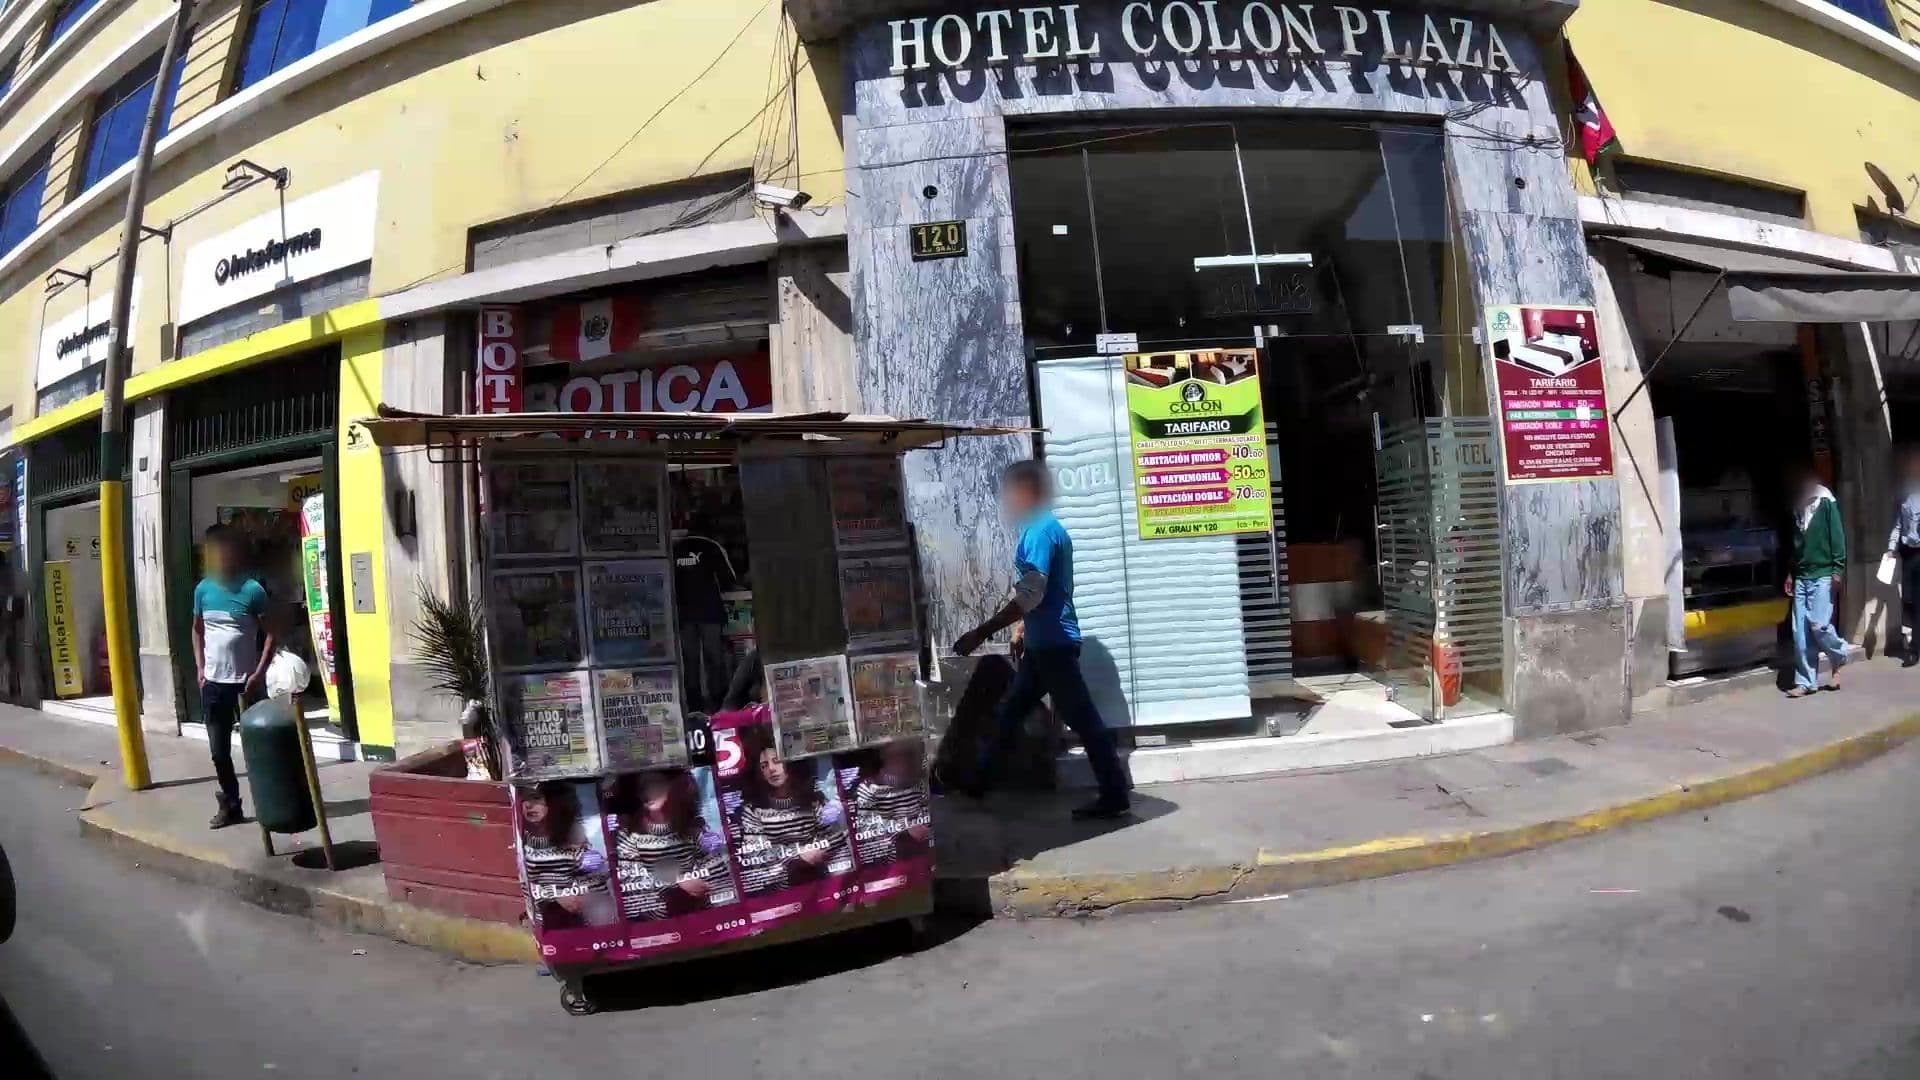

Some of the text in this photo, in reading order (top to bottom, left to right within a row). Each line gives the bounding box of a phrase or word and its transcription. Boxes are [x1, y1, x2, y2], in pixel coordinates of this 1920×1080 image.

[888, 1, 1520, 73] HOTEL COLON PLAZA
[918, 225, 959, 248] 120
[484, 310, 517, 415] BOT
[1529, 378, 1577, 387] TARIFARIO
[1170, 400, 1222, 413] COLON
[1165, 420, 1231, 433] TARIFARIO
[1138, 453, 1222, 466] HABITACIÓN JUNIOR
[1232, 447, 1264, 459] 40.00
[1056, 462, 1115, 491] OTEL
[1140, 472, 1222, 485] HAB. MATRIMONIAL
[1233, 465, 1265, 479] 50.00
[1141, 491, 1224, 504] HABITACIÓN DOBLE
[1236, 487, 1265, 499] 70.00
[1154, 526, 1167, 534] AV.
[1168, 525, 1193, 534] GRAU
[1203, 523, 1218, 532] 120
[601, 696, 630, 708] LIMPIA
[641, 692, 673, 704] TRACTO
[713, 727, 742, 770] 5
[888, 819, 902, 833] de
[795, 837, 830, 854] León
[530, 880, 589, 899] de León
